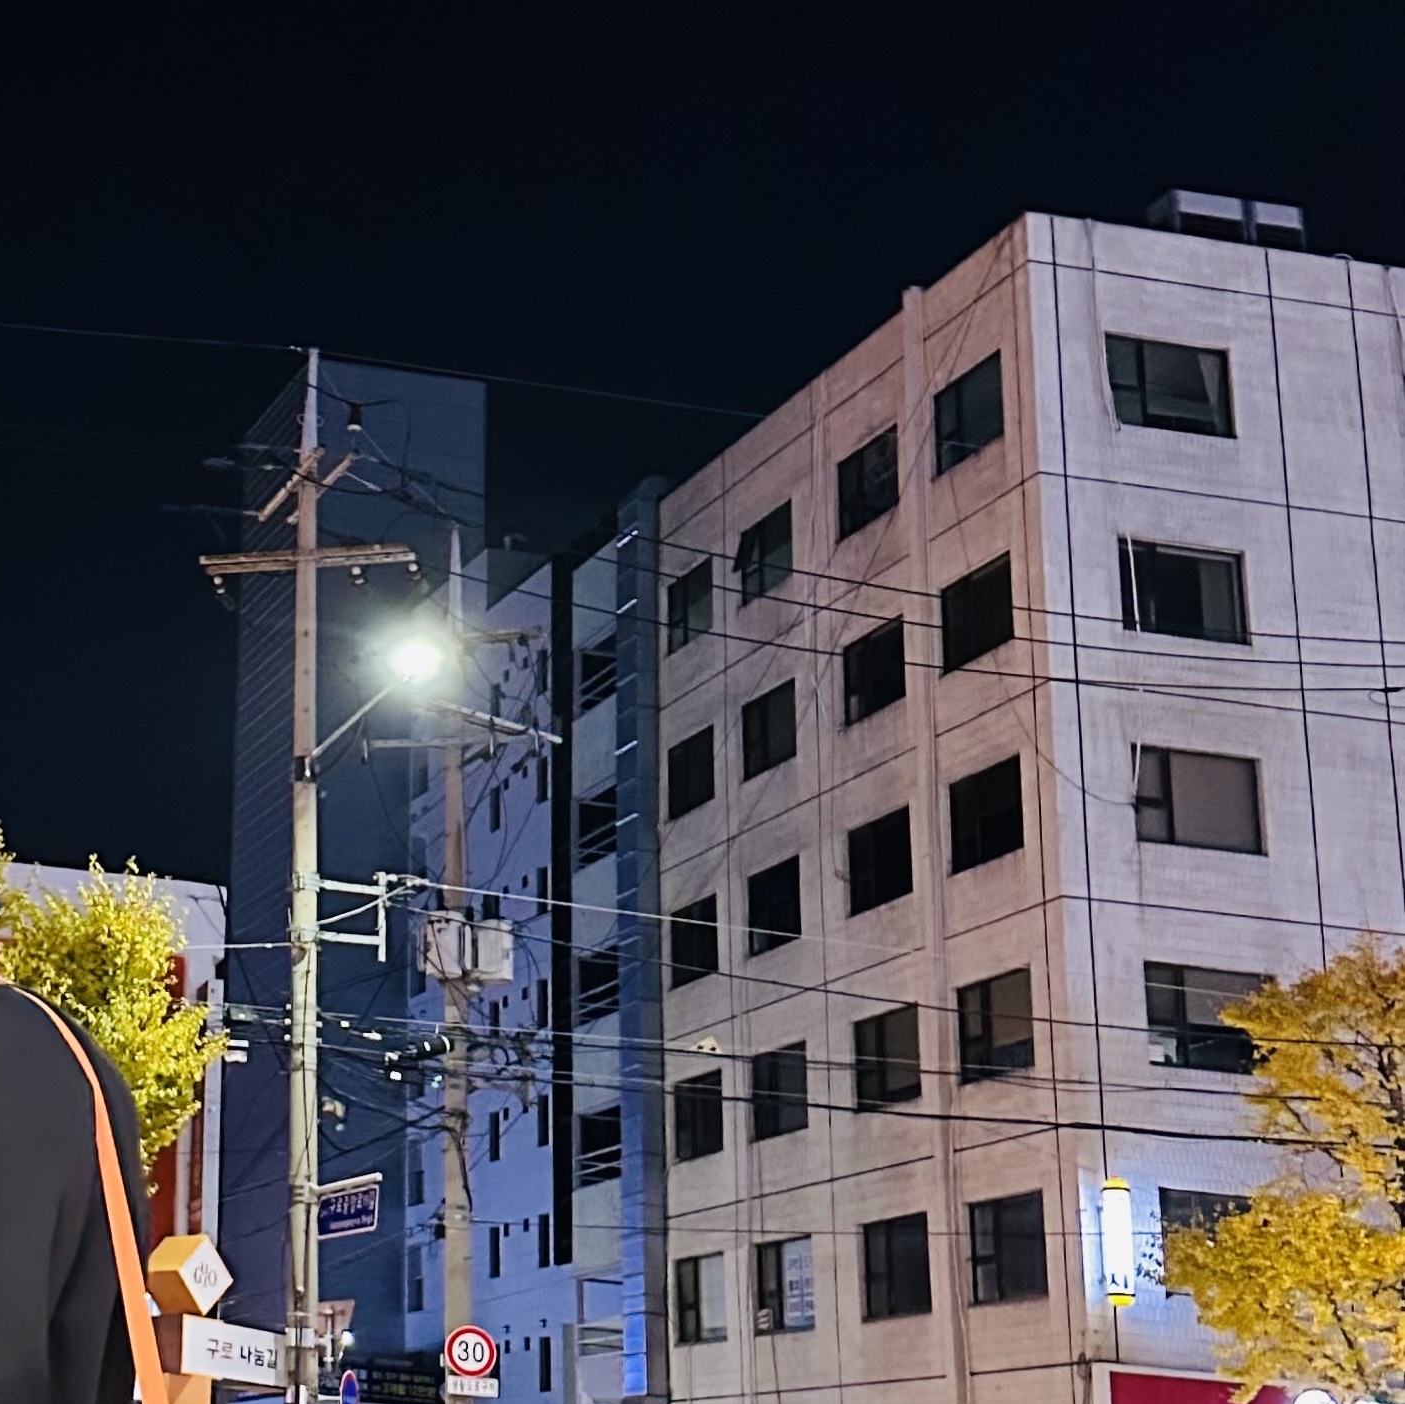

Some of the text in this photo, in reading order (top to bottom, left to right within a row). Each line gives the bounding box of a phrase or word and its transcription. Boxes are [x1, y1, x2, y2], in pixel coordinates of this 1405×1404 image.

[207, 1338, 278, 1370] 구로 나눔길
[457, 1340, 485, 1363] 30
